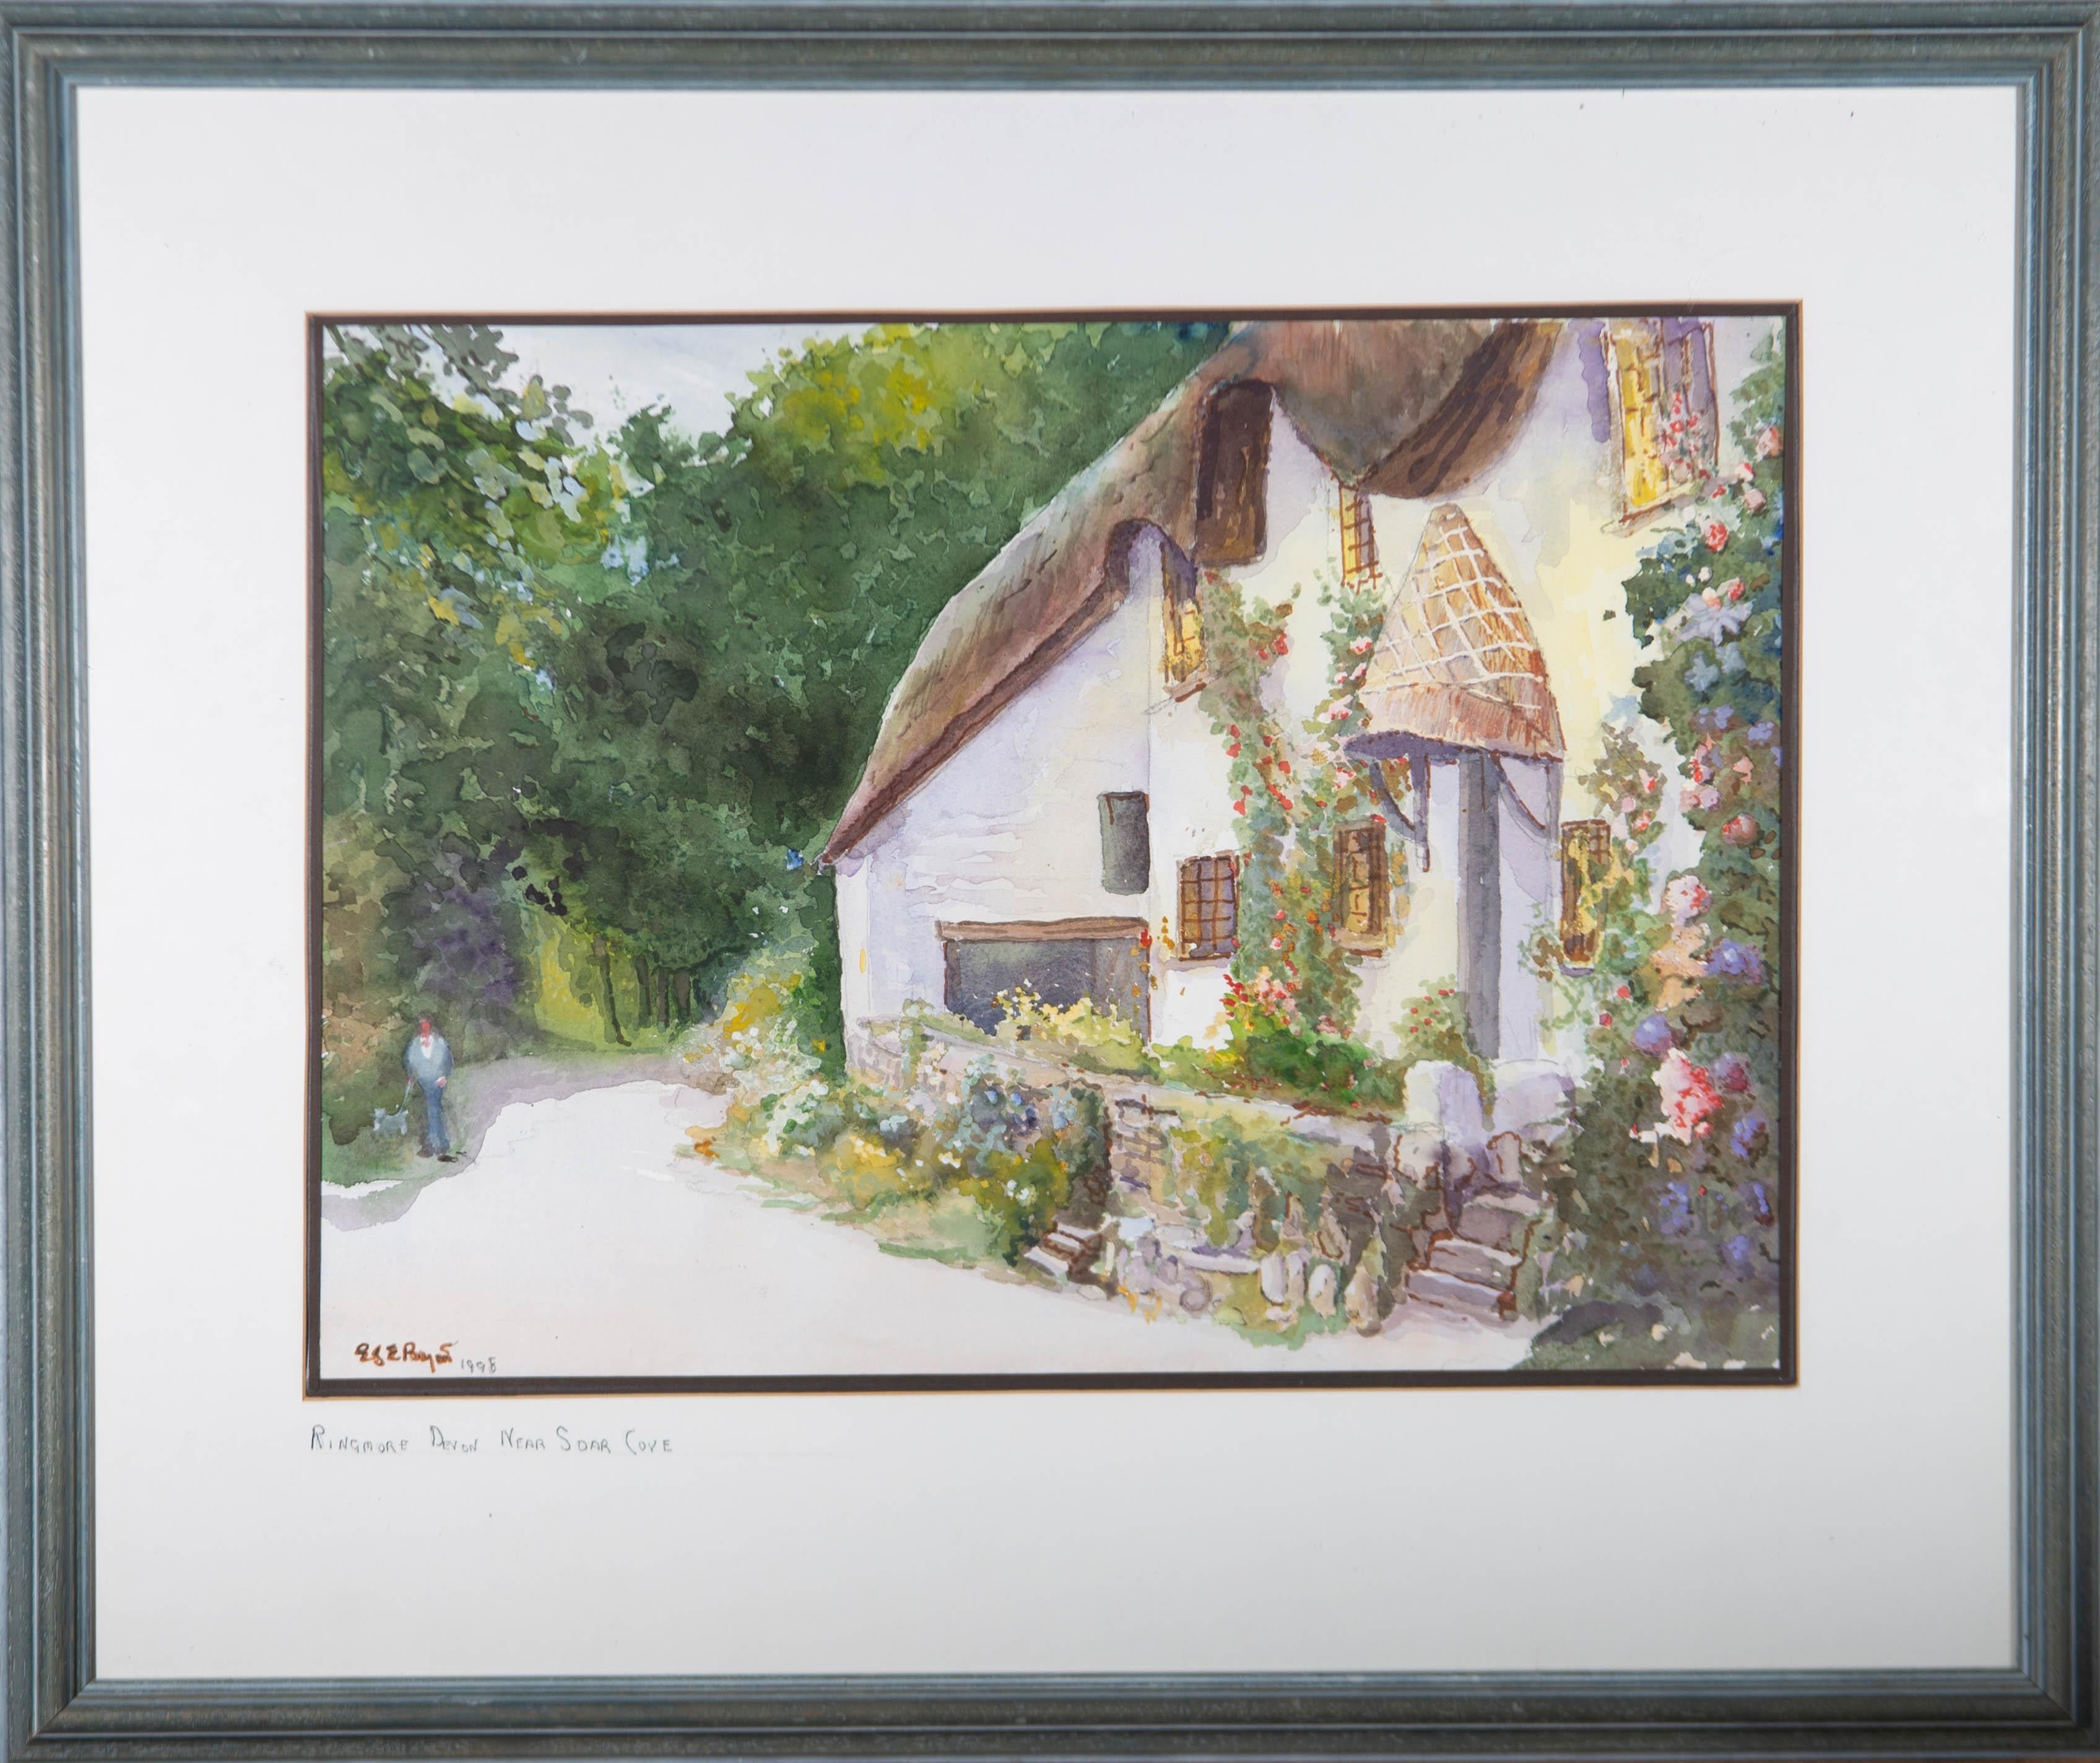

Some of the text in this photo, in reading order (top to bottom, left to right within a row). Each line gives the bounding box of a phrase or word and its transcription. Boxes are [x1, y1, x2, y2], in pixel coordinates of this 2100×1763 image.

[461, 1357, 497, 1373] 1998
[311, 1424, 409, 1453] RINGMORE
[429, 1425, 479, 1453] DEVON
[500, 1427, 545, 1451] NEAR
[625, 1429, 672, 1455] COVE
